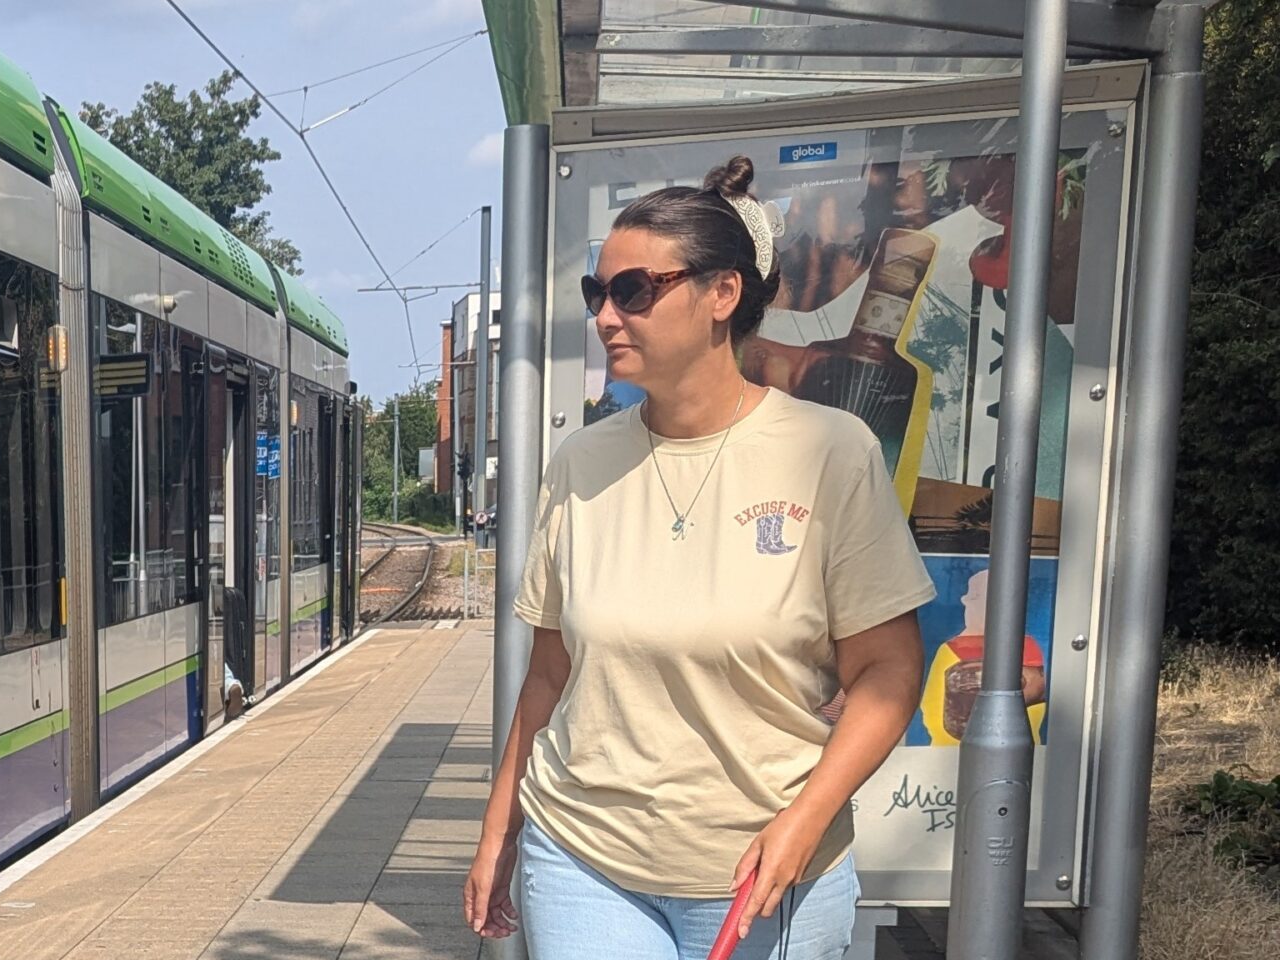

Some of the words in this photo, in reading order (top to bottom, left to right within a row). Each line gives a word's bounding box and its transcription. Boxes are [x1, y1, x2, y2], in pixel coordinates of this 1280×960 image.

[792, 144, 825, 160] global
[733, 501, 787, 527] EXCUSE
[787, 503, 810, 523] ME
[883, 774, 956, 817] Alice
